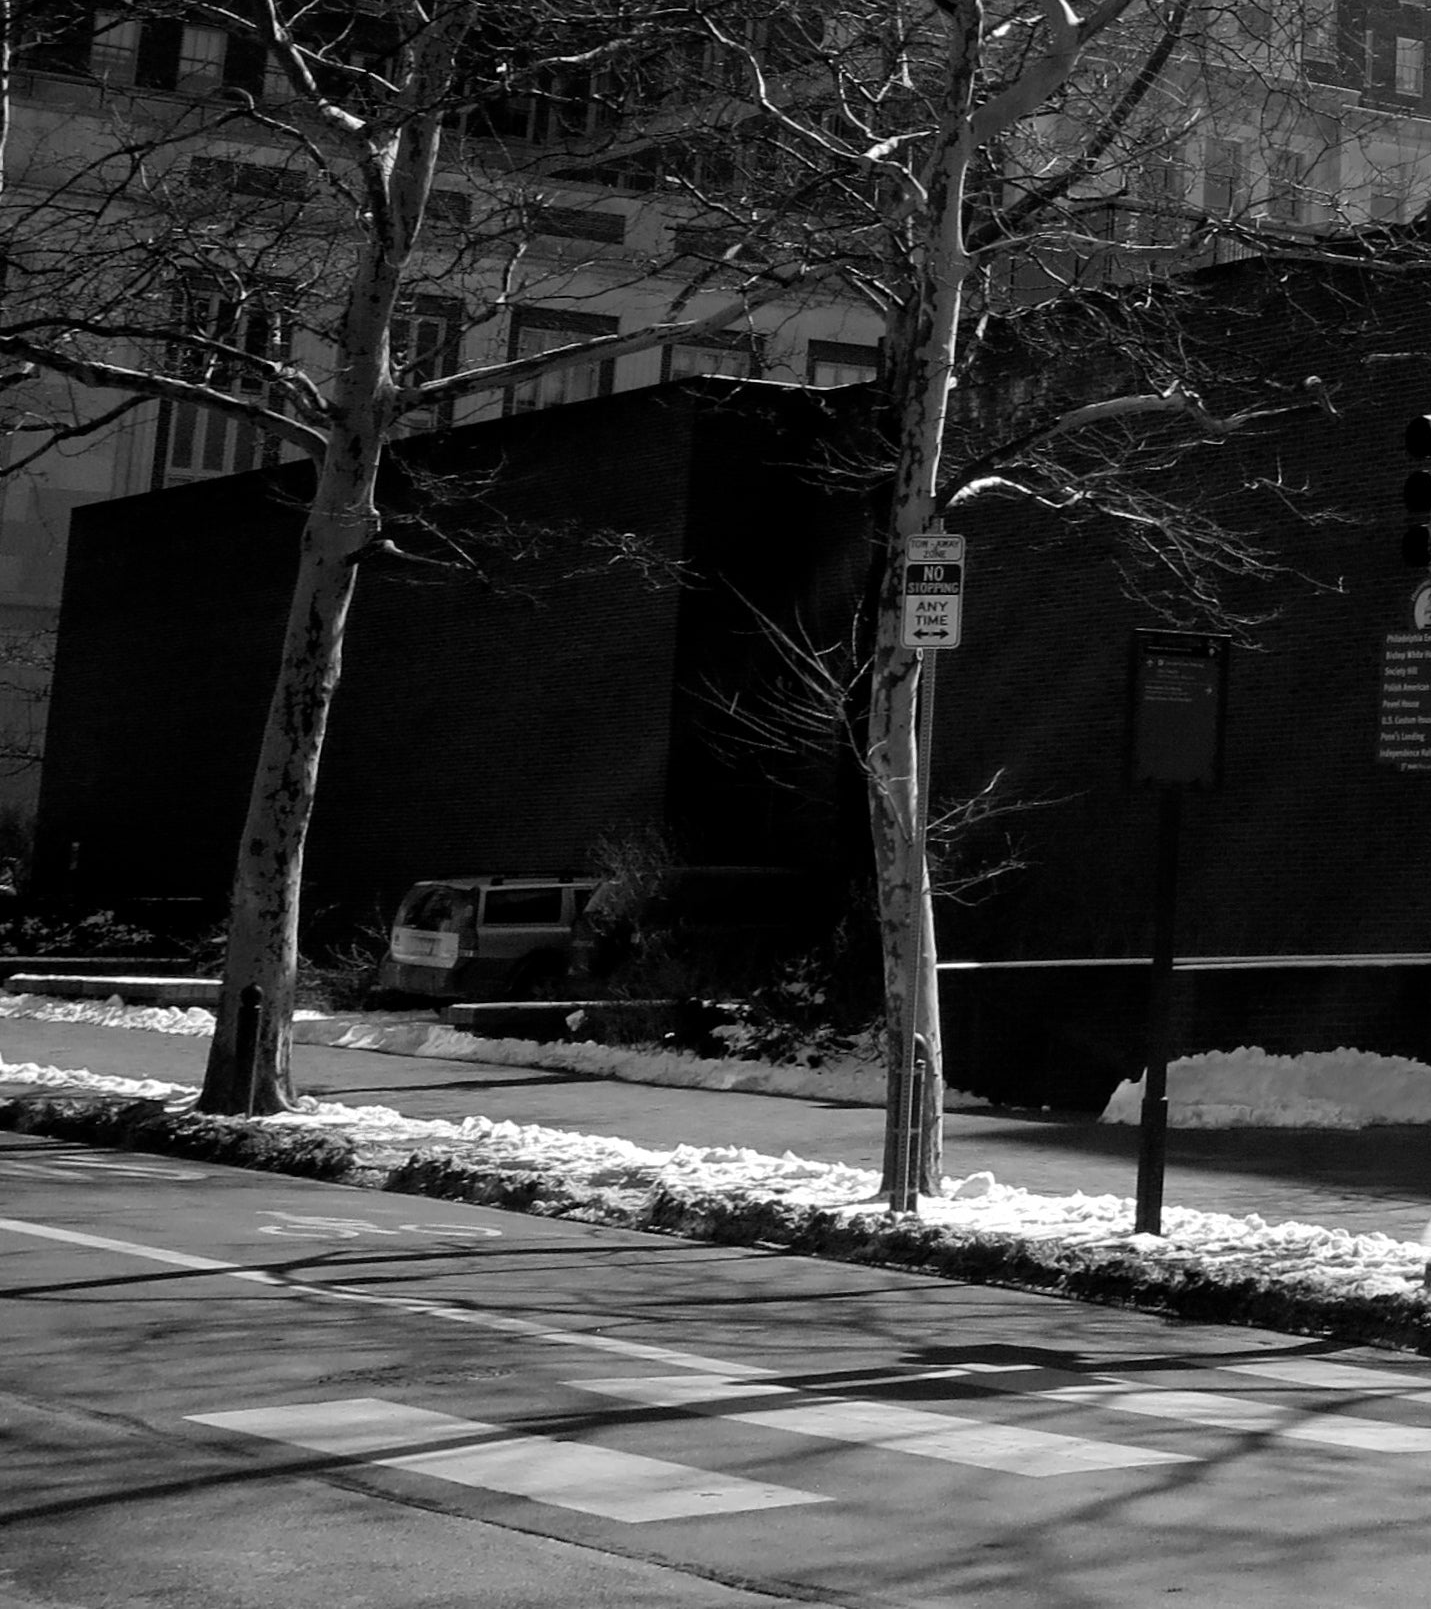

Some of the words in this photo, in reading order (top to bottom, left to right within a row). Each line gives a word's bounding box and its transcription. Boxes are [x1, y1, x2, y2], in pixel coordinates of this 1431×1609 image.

[923, 550, 947, 559] ZONE
[923, 565, 944, 582] NO
[907, 582, 959, 594] STOPPING
[916, 601, 949, 612] ANY
[915, 615, 949, 626] TIME
[1386, 634, 1423, 643] Philadelphia
[1403, 683, 1430, 691] American
[1401, 732, 1425, 742] Landing
[1379, 748, 1420, 759] Independence
